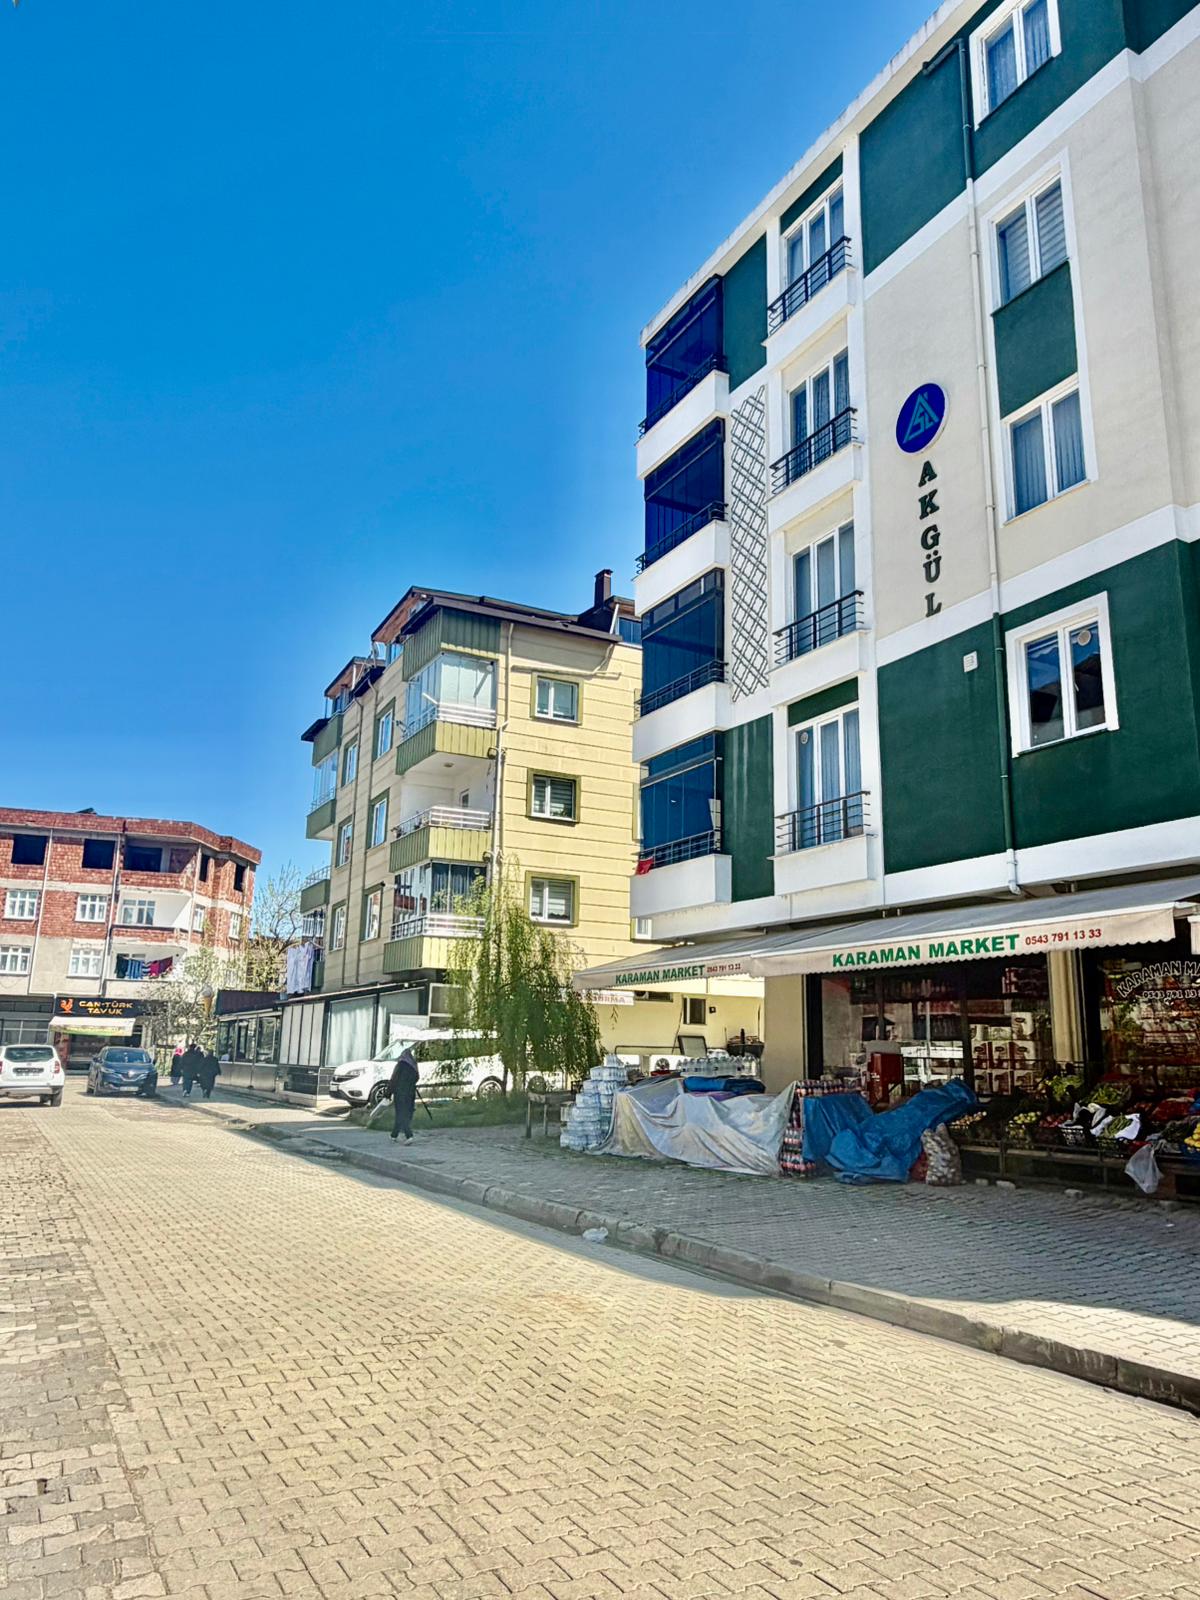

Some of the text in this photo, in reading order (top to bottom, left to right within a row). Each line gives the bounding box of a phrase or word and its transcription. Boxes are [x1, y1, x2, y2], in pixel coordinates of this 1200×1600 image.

[918, 460, 942, 617] AKGÜL
[832, 928, 1102, 967] KARAMAN MARKET 0543 791 13 33
[615, 970, 660, 985] KARAMAN
[662, 964, 706, 980] MARKET
[1116, 960, 1181, 998] KARAMAN
